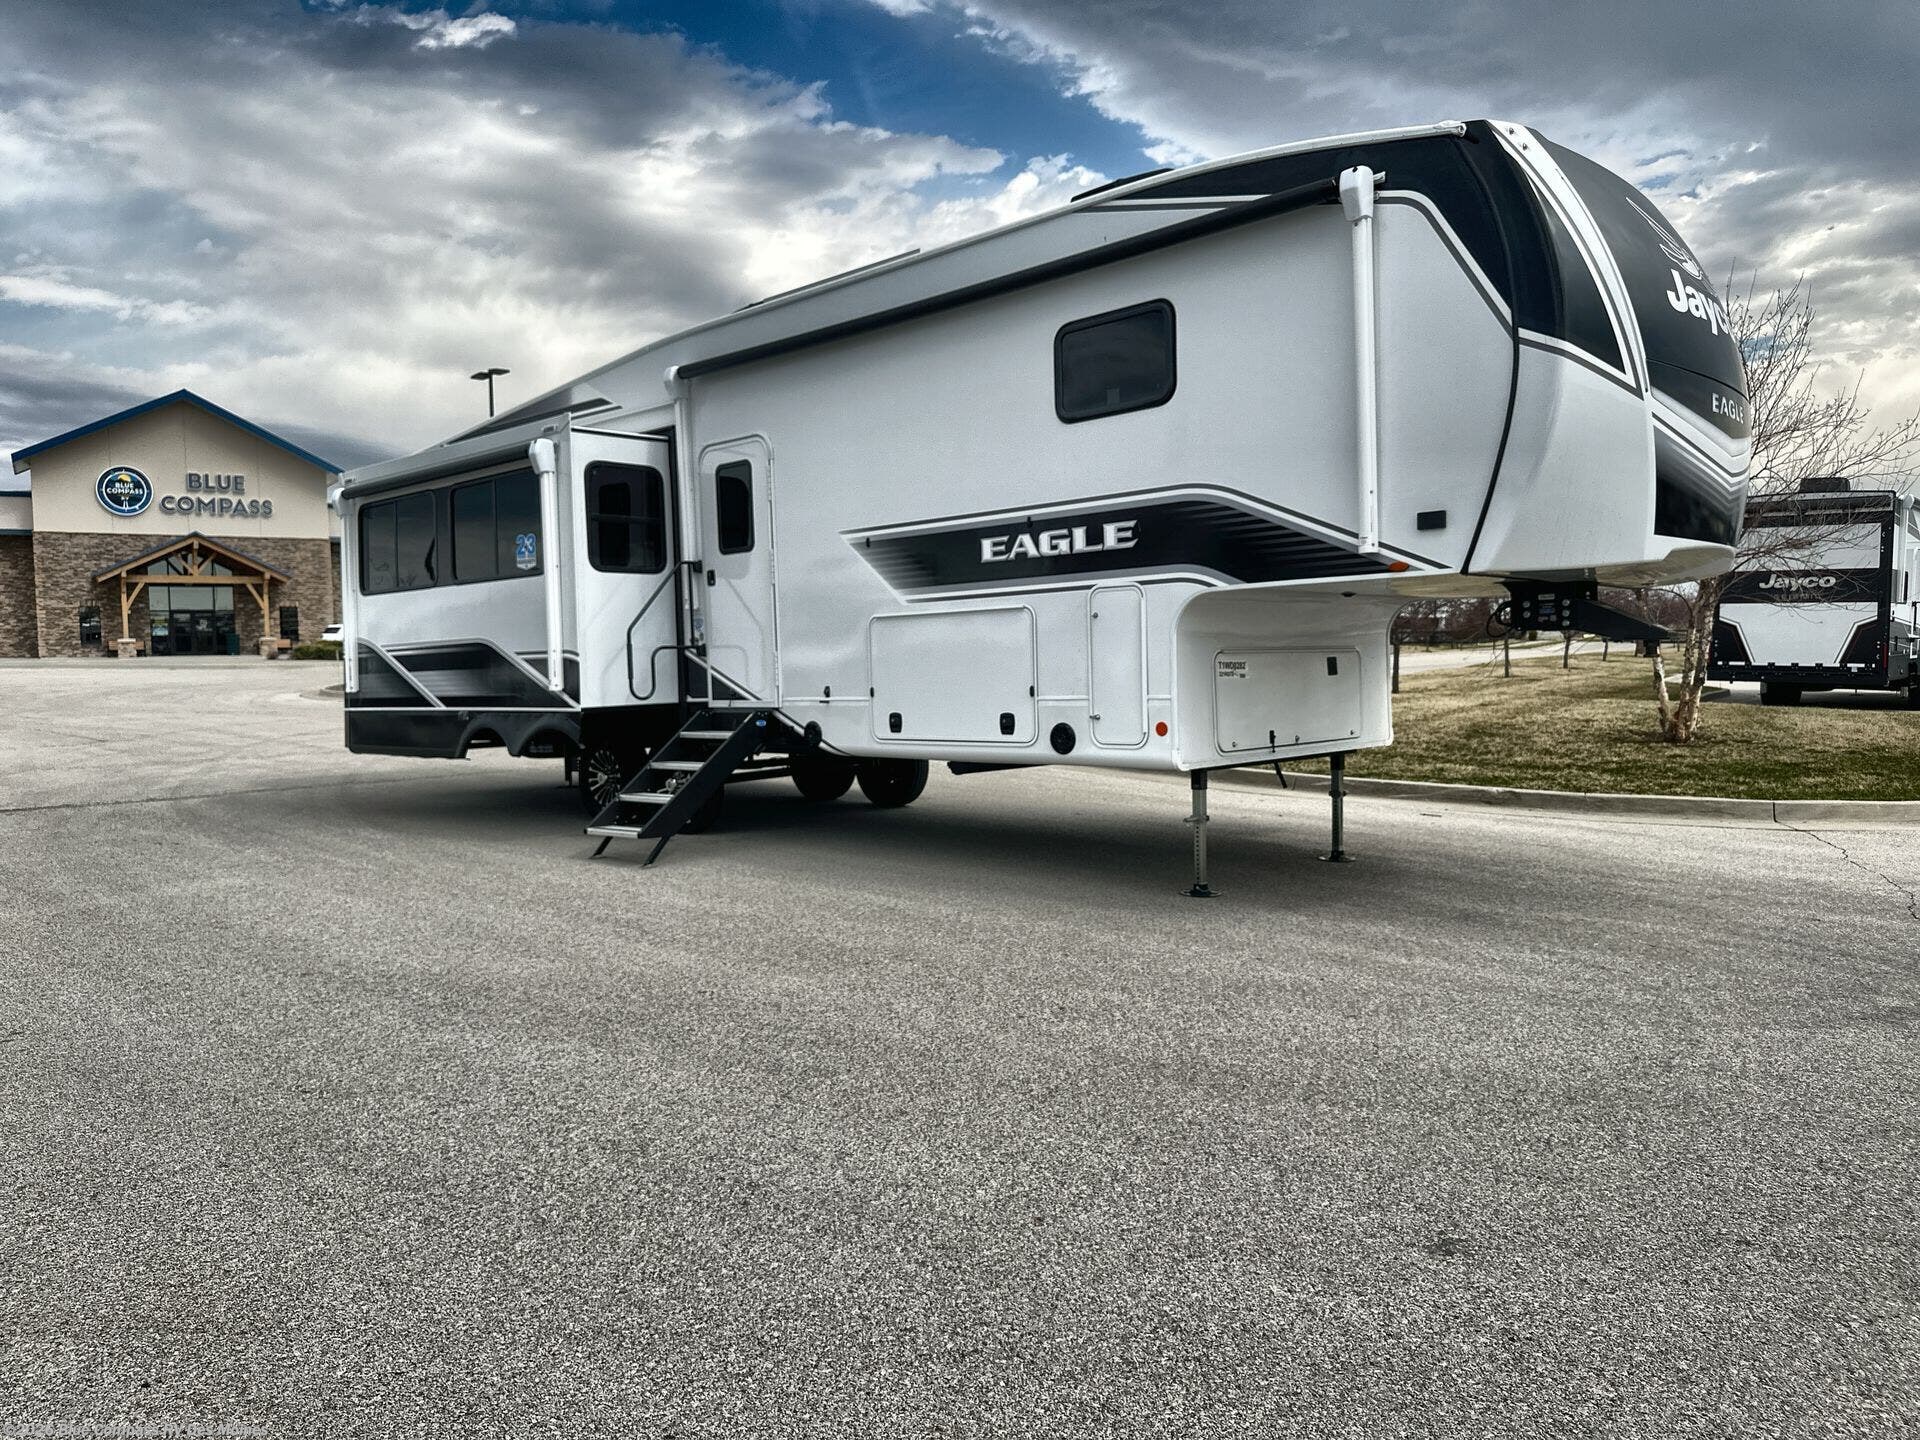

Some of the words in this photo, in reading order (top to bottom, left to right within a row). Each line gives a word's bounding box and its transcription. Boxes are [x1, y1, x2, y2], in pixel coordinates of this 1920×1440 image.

[1666, 268, 1732, 336] Jayc
[1712, 392, 1744, 425] EAGLE
[106, 487, 144, 495] COMPASS
[187, 472, 245, 493] BLUE
[160, 495, 273, 518] COMPASS
[980, 519, 1139, 564] EAGLE
[1759, 573, 1836, 592] Jayco
